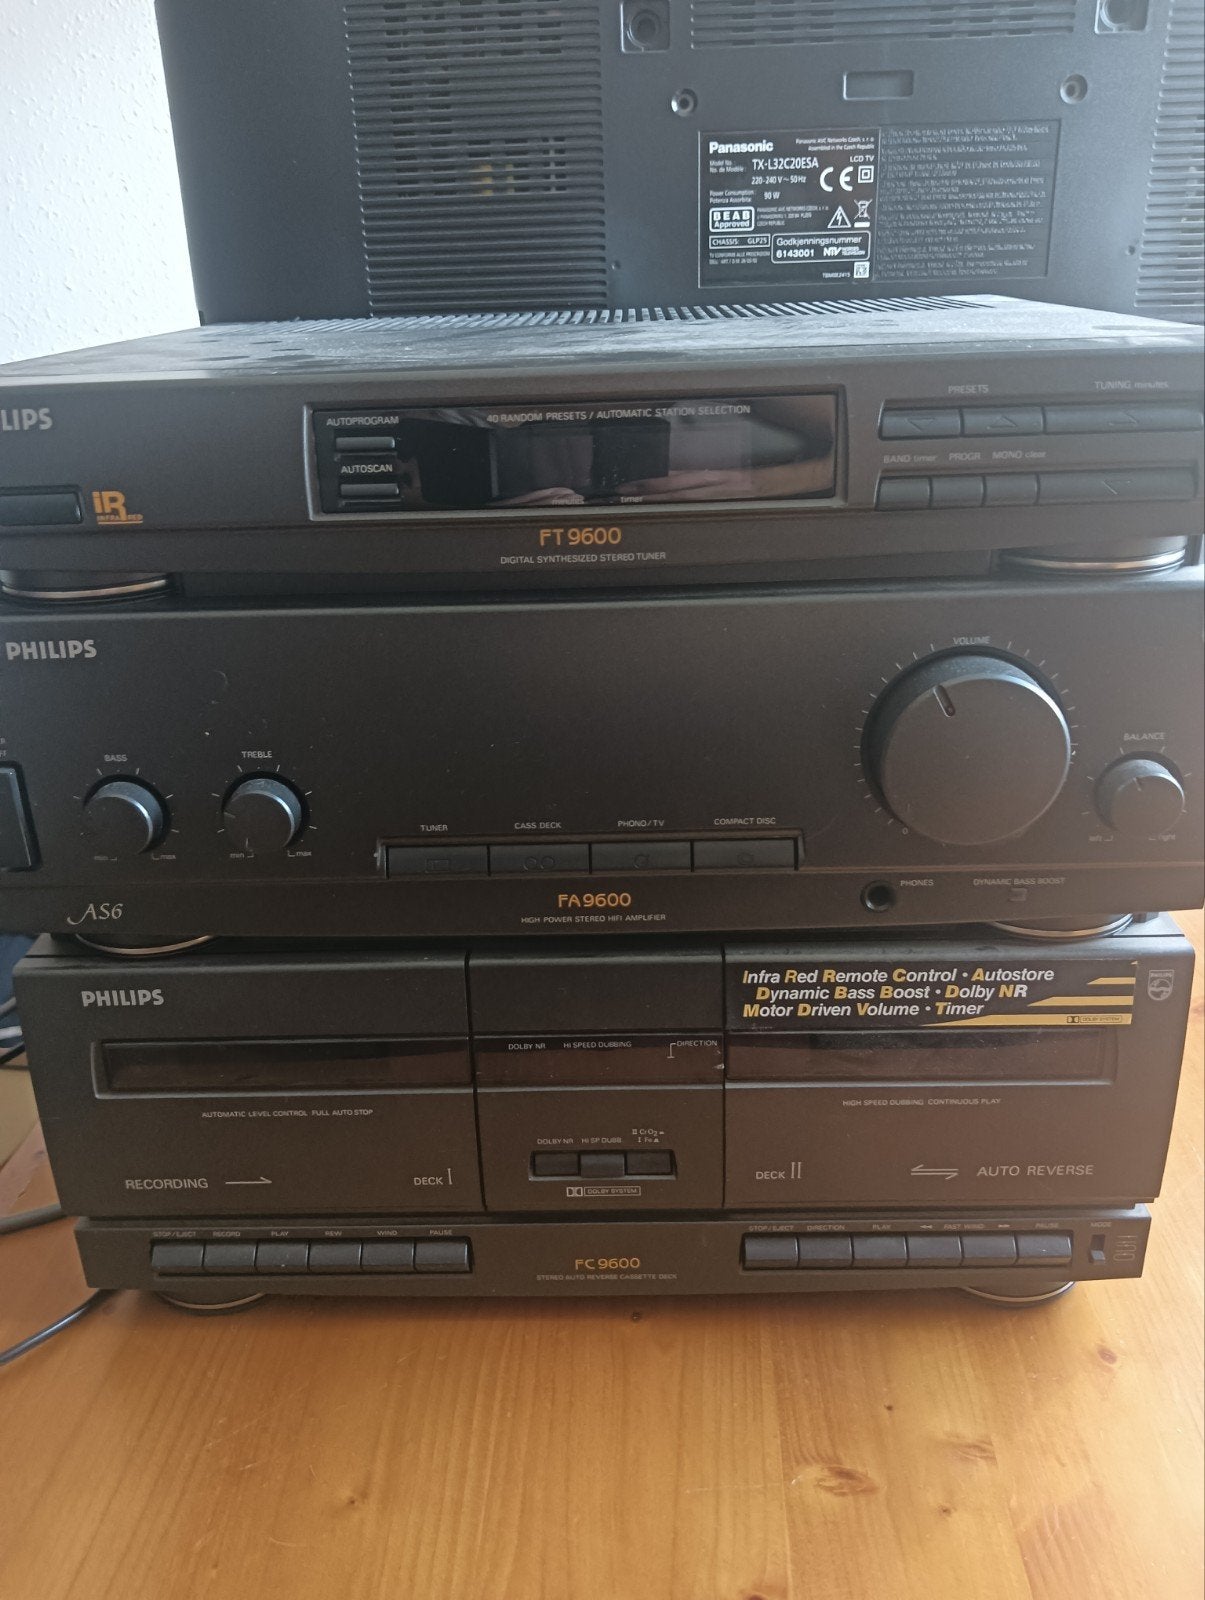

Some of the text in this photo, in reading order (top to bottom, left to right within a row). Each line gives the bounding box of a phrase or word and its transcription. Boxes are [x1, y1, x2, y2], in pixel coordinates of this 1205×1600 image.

[709, 139, 774, 154] Panasonic
[865, 154, 875, 162] TV
[751, 156, 819, 171] TX-L32C20ESA
[751, 176, 777, 185] 220-240
[820, 165, 854, 193] CE
[764, 191, 780, 200] 90 W
[713, 210, 751, 221] BEAB
[714, 220, 750, 230] Approved
[776, 236, 862, 247] Godkjenningsnummer
[776, 248, 814, 258] 6143001
[948, 384, 989, 395] PRESETS
[1094, 379, 1169, 390] TUNING minutes
[486, 414, 499, 423] 40
[500, 412, 543, 423] RANDOM
[545, 411, 587, 421] PRESETS
[596, 408, 652, 419] AUTOMATIC
[655, 406, 696, 417] STATION
[697, 405, 751, 415] SELECTION
[326, 415, 400, 427] AUTOPROGRAM
[883, 454, 938, 463] BAND timer
[948, 452, 981, 461] PROGR
[992, 449, 1047, 460] MONO clear
[340, 463, 393, 474] AUTOSCAN
[620, 496, 643, 504] timer
[92, 490, 128, 522] IR
[500, 551, 667, 565] DIGITAL SYNTHESIZED STEREO TUNER
[953, 635, 991, 646] VOLUME
[5, 639, 98, 660] PHILIPS
[1123, 732, 1166, 742] BALANCE
[104, 754, 128, 762] BASS
[241, 750, 273, 759] TREBLE
[514, 821, 562, 830] CASS DECK
[617, 819, 665, 829] PHONO/TV
[714, 816, 777, 826] COMPACT DISC
[420, 823, 449, 832] TUNER
[160, 853, 177, 861] max
[229, 851, 245, 859] min
[295, 849, 312, 858] max
[900, 879, 934, 888] PHONES
[973, 876, 1066, 887] DYNAMIC BASS BOOST
[66, 902, 124, 925] AS6
[520, 913, 667, 924] HIGH POWER STEREO HIFI AMPLIFIER
[742, 967, 1055, 985] Infra Red Remote Control Autostore
[81, 988, 165, 1008] PHILIPS
[755, 983, 1028, 1003] Dynamic Bass Boost Dolby NR
[742, 1001, 985, 1019] Motor Driven Volume Timer
[508, 1042, 546, 1051] DOLBY NR
[573, 1041, 597, 1049] SPEED
[598, 1040, 633, 1049] DUBBING
[676, 1038, 719, 1047] DIRECTION
[842, 1097, 1002, 1107] HIGH SPEED DUBBING CONTINUOUS PLAY
[201, 1107, 374, 1119] AUTOMATIC LEVEL CONTROL FULL AUTO STOP
[590, 1136, 601, 1144] SP
[601, 1136, 622, 1144] DUBB
[755, 1170, 786, 1181] DECK
[976, 1164, 1095, 1178] AUTO REVERSE
[125, 1178, 209, 1191] RECORDING
[413, 1176, 444, 1187] DECK
[587, 1187, 639, 1196] DOLBY SYSTEM
[806, 1223, 846, 1232] DIRECTION
[872, 1223, 892, 1231] PLAY
[943, 1222, 961, 1231] FAST
[1035, 1221, 1060, 1230] PAUSE
[212, 1230, 241, 1238] RECORD
[270, 1230, 289, 1238] PLAY
[429, 1228, 453, 1236] PAUSE
[536, 1272, 678, 1282] STEREO AUTO REVERSE CASSETTE DECK
